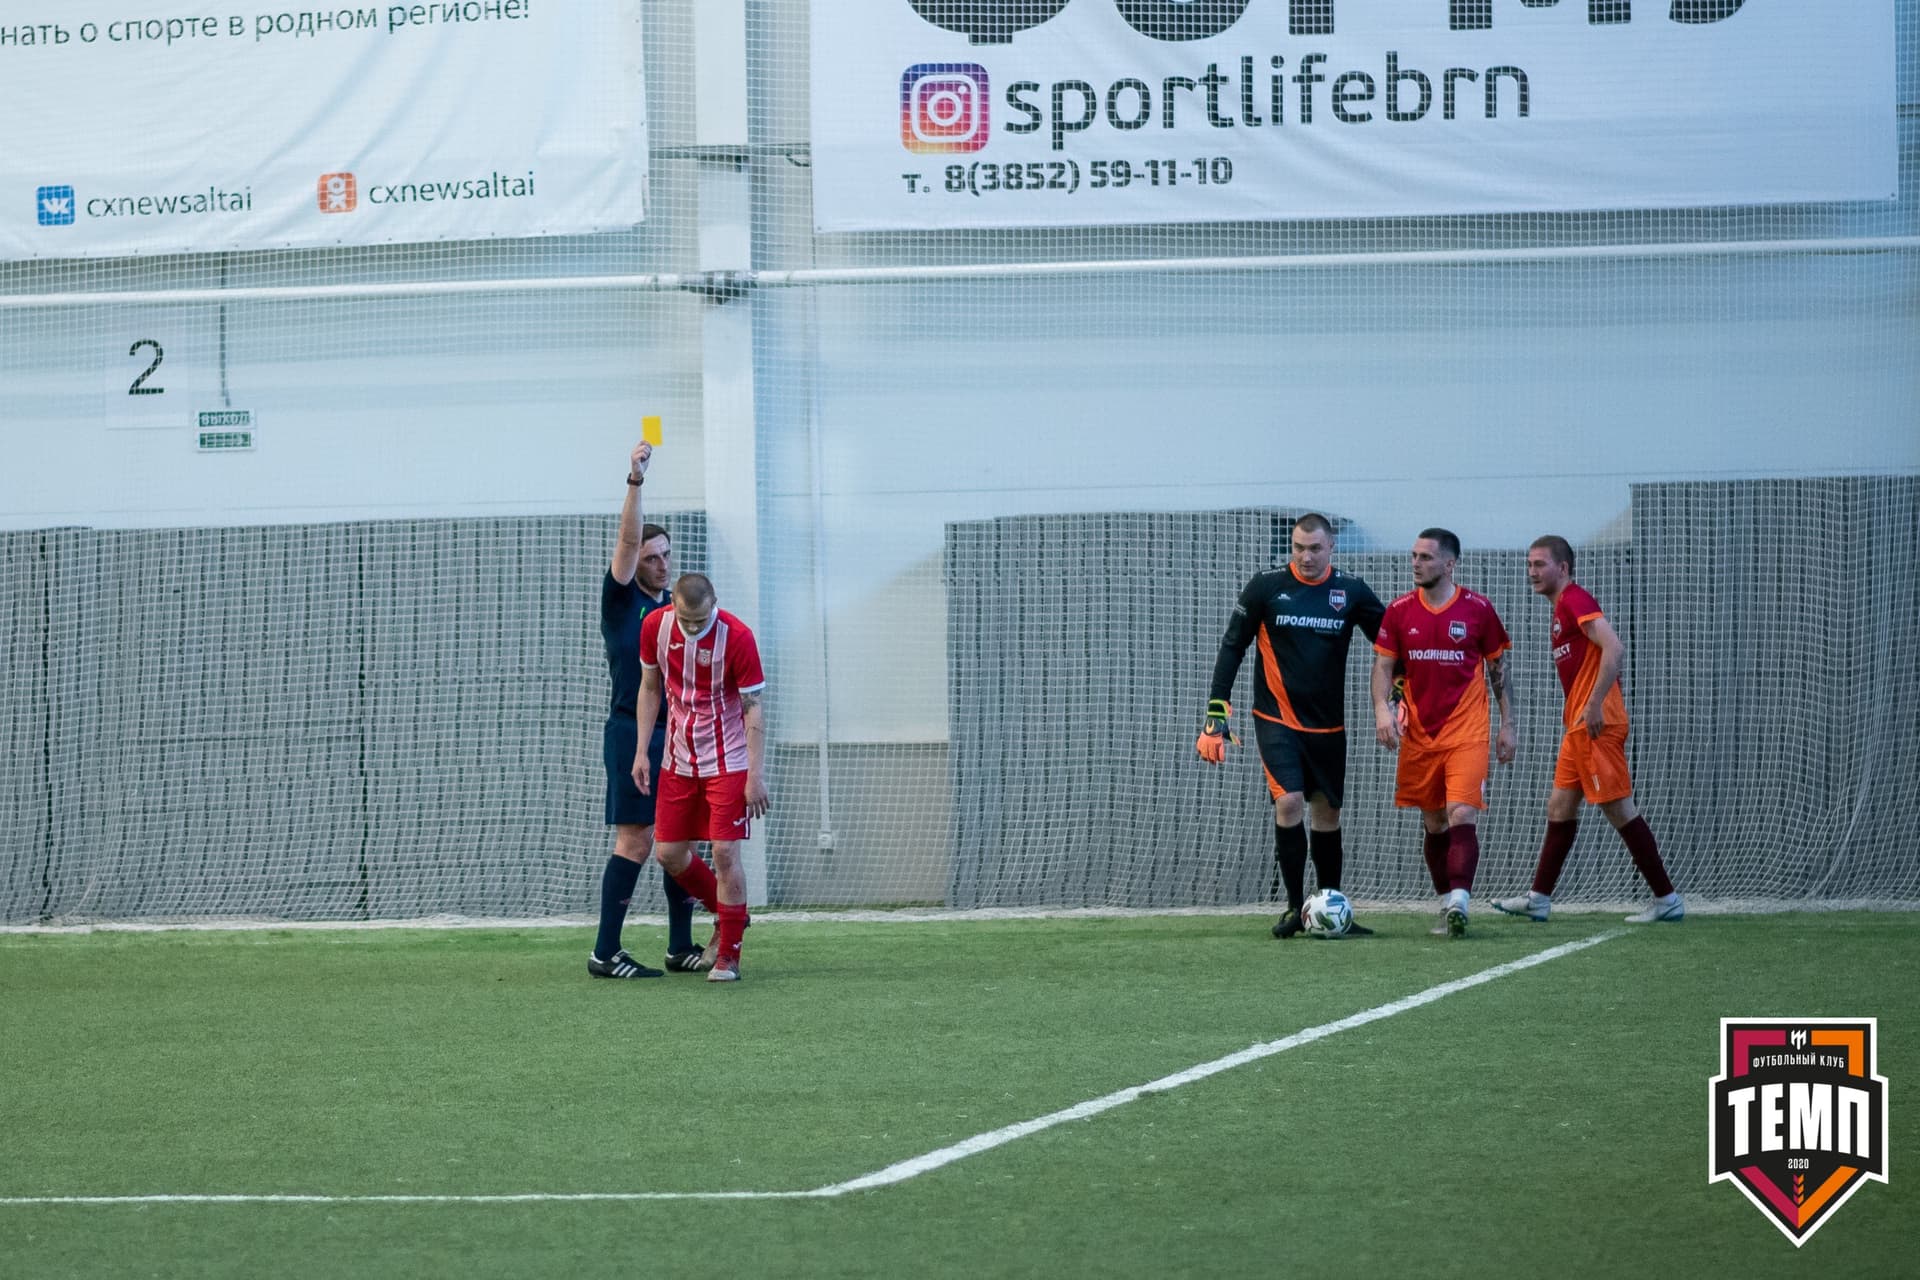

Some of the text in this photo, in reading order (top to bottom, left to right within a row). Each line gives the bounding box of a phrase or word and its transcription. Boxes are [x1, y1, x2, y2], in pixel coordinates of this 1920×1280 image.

[79, 22, 99, 43] о
[107, 16, 219, 46] спорте
[228, 15, 246, 36] в
[255, 8, 378, 42] родном
[388, 0, 530, 33] регионе!
[1003, 51, 1530, 151] sportlifebrn
[369, 171, 535, 205] cxnewsaltai
[945, 160, 1080, 196] 8(3852)
[1090, 157, 1233, 187] 59-11-10
[87, 187, 253, 218] cxnewsaltai
[129, 339, 164, 395] 2
[1275, 614, 1345, 630] ПРОДИНВЕСТ
